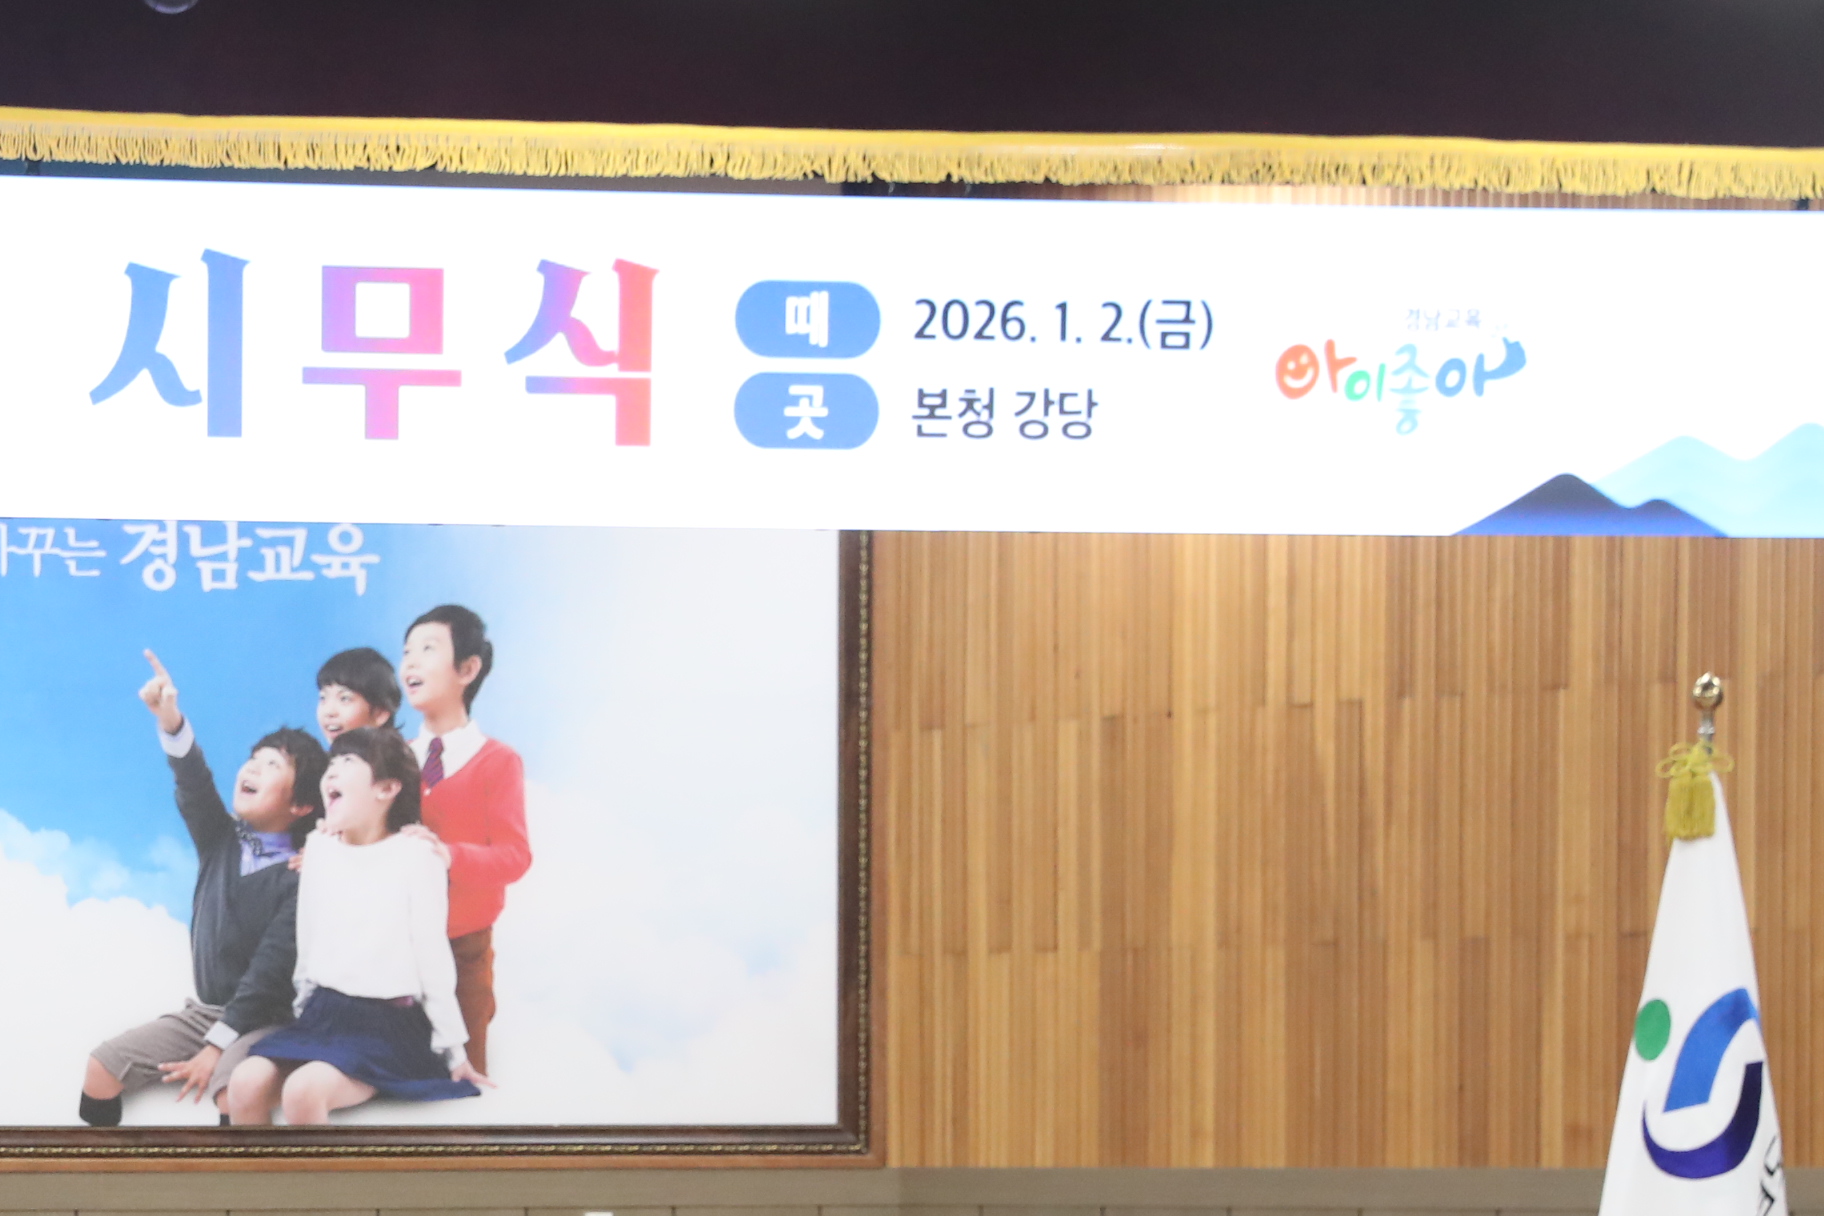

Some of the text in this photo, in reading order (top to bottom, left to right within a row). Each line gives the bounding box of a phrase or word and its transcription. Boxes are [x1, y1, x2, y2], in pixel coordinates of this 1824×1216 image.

[784, 289, 830, 348] 때
[913, 298, 1038, 343] 2026.
[1053, 301, 1083, 344] 1.
[88, 247, 661, 448] 시무식
[783, 384, 829, 440] 곳
[911, 386, 1099, 440] 본청 강당
[119, 521, 382, 596] 경남교육
